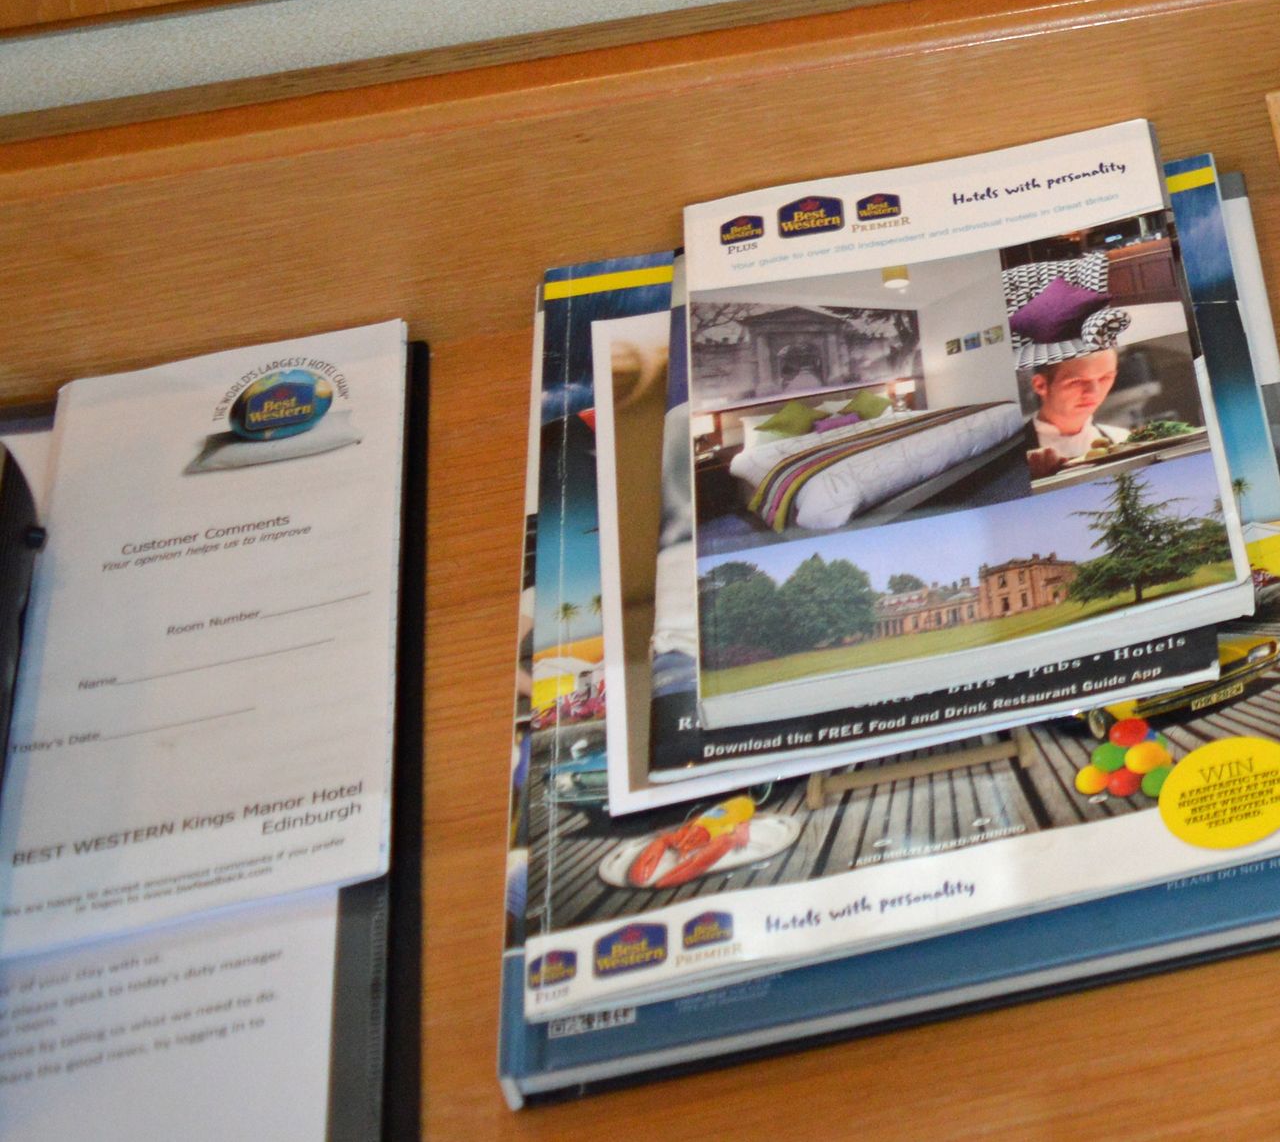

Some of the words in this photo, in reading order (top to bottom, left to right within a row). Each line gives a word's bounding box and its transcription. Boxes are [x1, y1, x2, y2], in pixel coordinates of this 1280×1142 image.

[951, 186, 998, 205] Hotels
[1004, 177, 1041, 195] with
[1046, 161, 1126, 189] personality
[793, 206, 826, 223] Best
[857, 203, 901, 220] Western
[866, 199, 889, 211] Best
[721, 227, 763, 243] Western
[730, 222, 752, 234] Best
[781, 211, 842, 236] Western
[850, 213, 912, 235] PREMIER
[726, 240, 758, 255] PLUS
[212, 404, 227, 422] THE
[257, 357, 308, 375] LARGEST
[307, 358, 337, 377] HOTEL
[249, 404, 313, 423] Western
[263, 396, 298, 412] Best
[121, 531, 200, 556] Customer
[204, 513, 291, 540] Comments
[100, 560, 132, 573] Your
[133, 550, 183, 569] opinion
[185, 542, 221, 559] helps
[223, 540, 239, 551] us
[242, 535, 257, 547] to
[259, 524, 312, 544] improve
[166, 619, 206, 637] Room
[208, 608, 261, 629] Number
[1112, 635, 1187, 662] Hotels
[77, 674, 118, 691] Name
[703, 733, 783, 759] Download
[787, 729, 813, 746] the
[817, 721, 863, 742] FREE
[868, 714, 906, 733] Food
[910, 708, 939, 725] and
[944, 699, 988, 719] Drink
[992, 682, 1078, 710] Restaurant
[1081, 672, 1127, 693] Guide
[1130, 664, 1162, 683] App
[68, 729, 101, 747] Date
[1188, 775, 1250, 796] FANTASTIC
[1252, 768, 1279, 782] TWO
[1198, 756, 1254, 784] WIN
[1190, 802, 1216, 815] BEST
[1219, 787, 1274, 807] WESTERN
[12, 845, 65, 868] BEST
[72, 821, 175, 856] WESTERN
[181, 809, 237, 834] Kings
[242, 794, 306, 819] Manor
[311, 780, 365, 805] Hotel
[261, 801, 362, 836] Edinburgh
[763, 903, 822, 937] Hotels
[827, 894, 873, 923] with
[877, 872, 977, 916] personality
[595, 944, 666, 976] Western
[611, 938, 648, 960] Best
